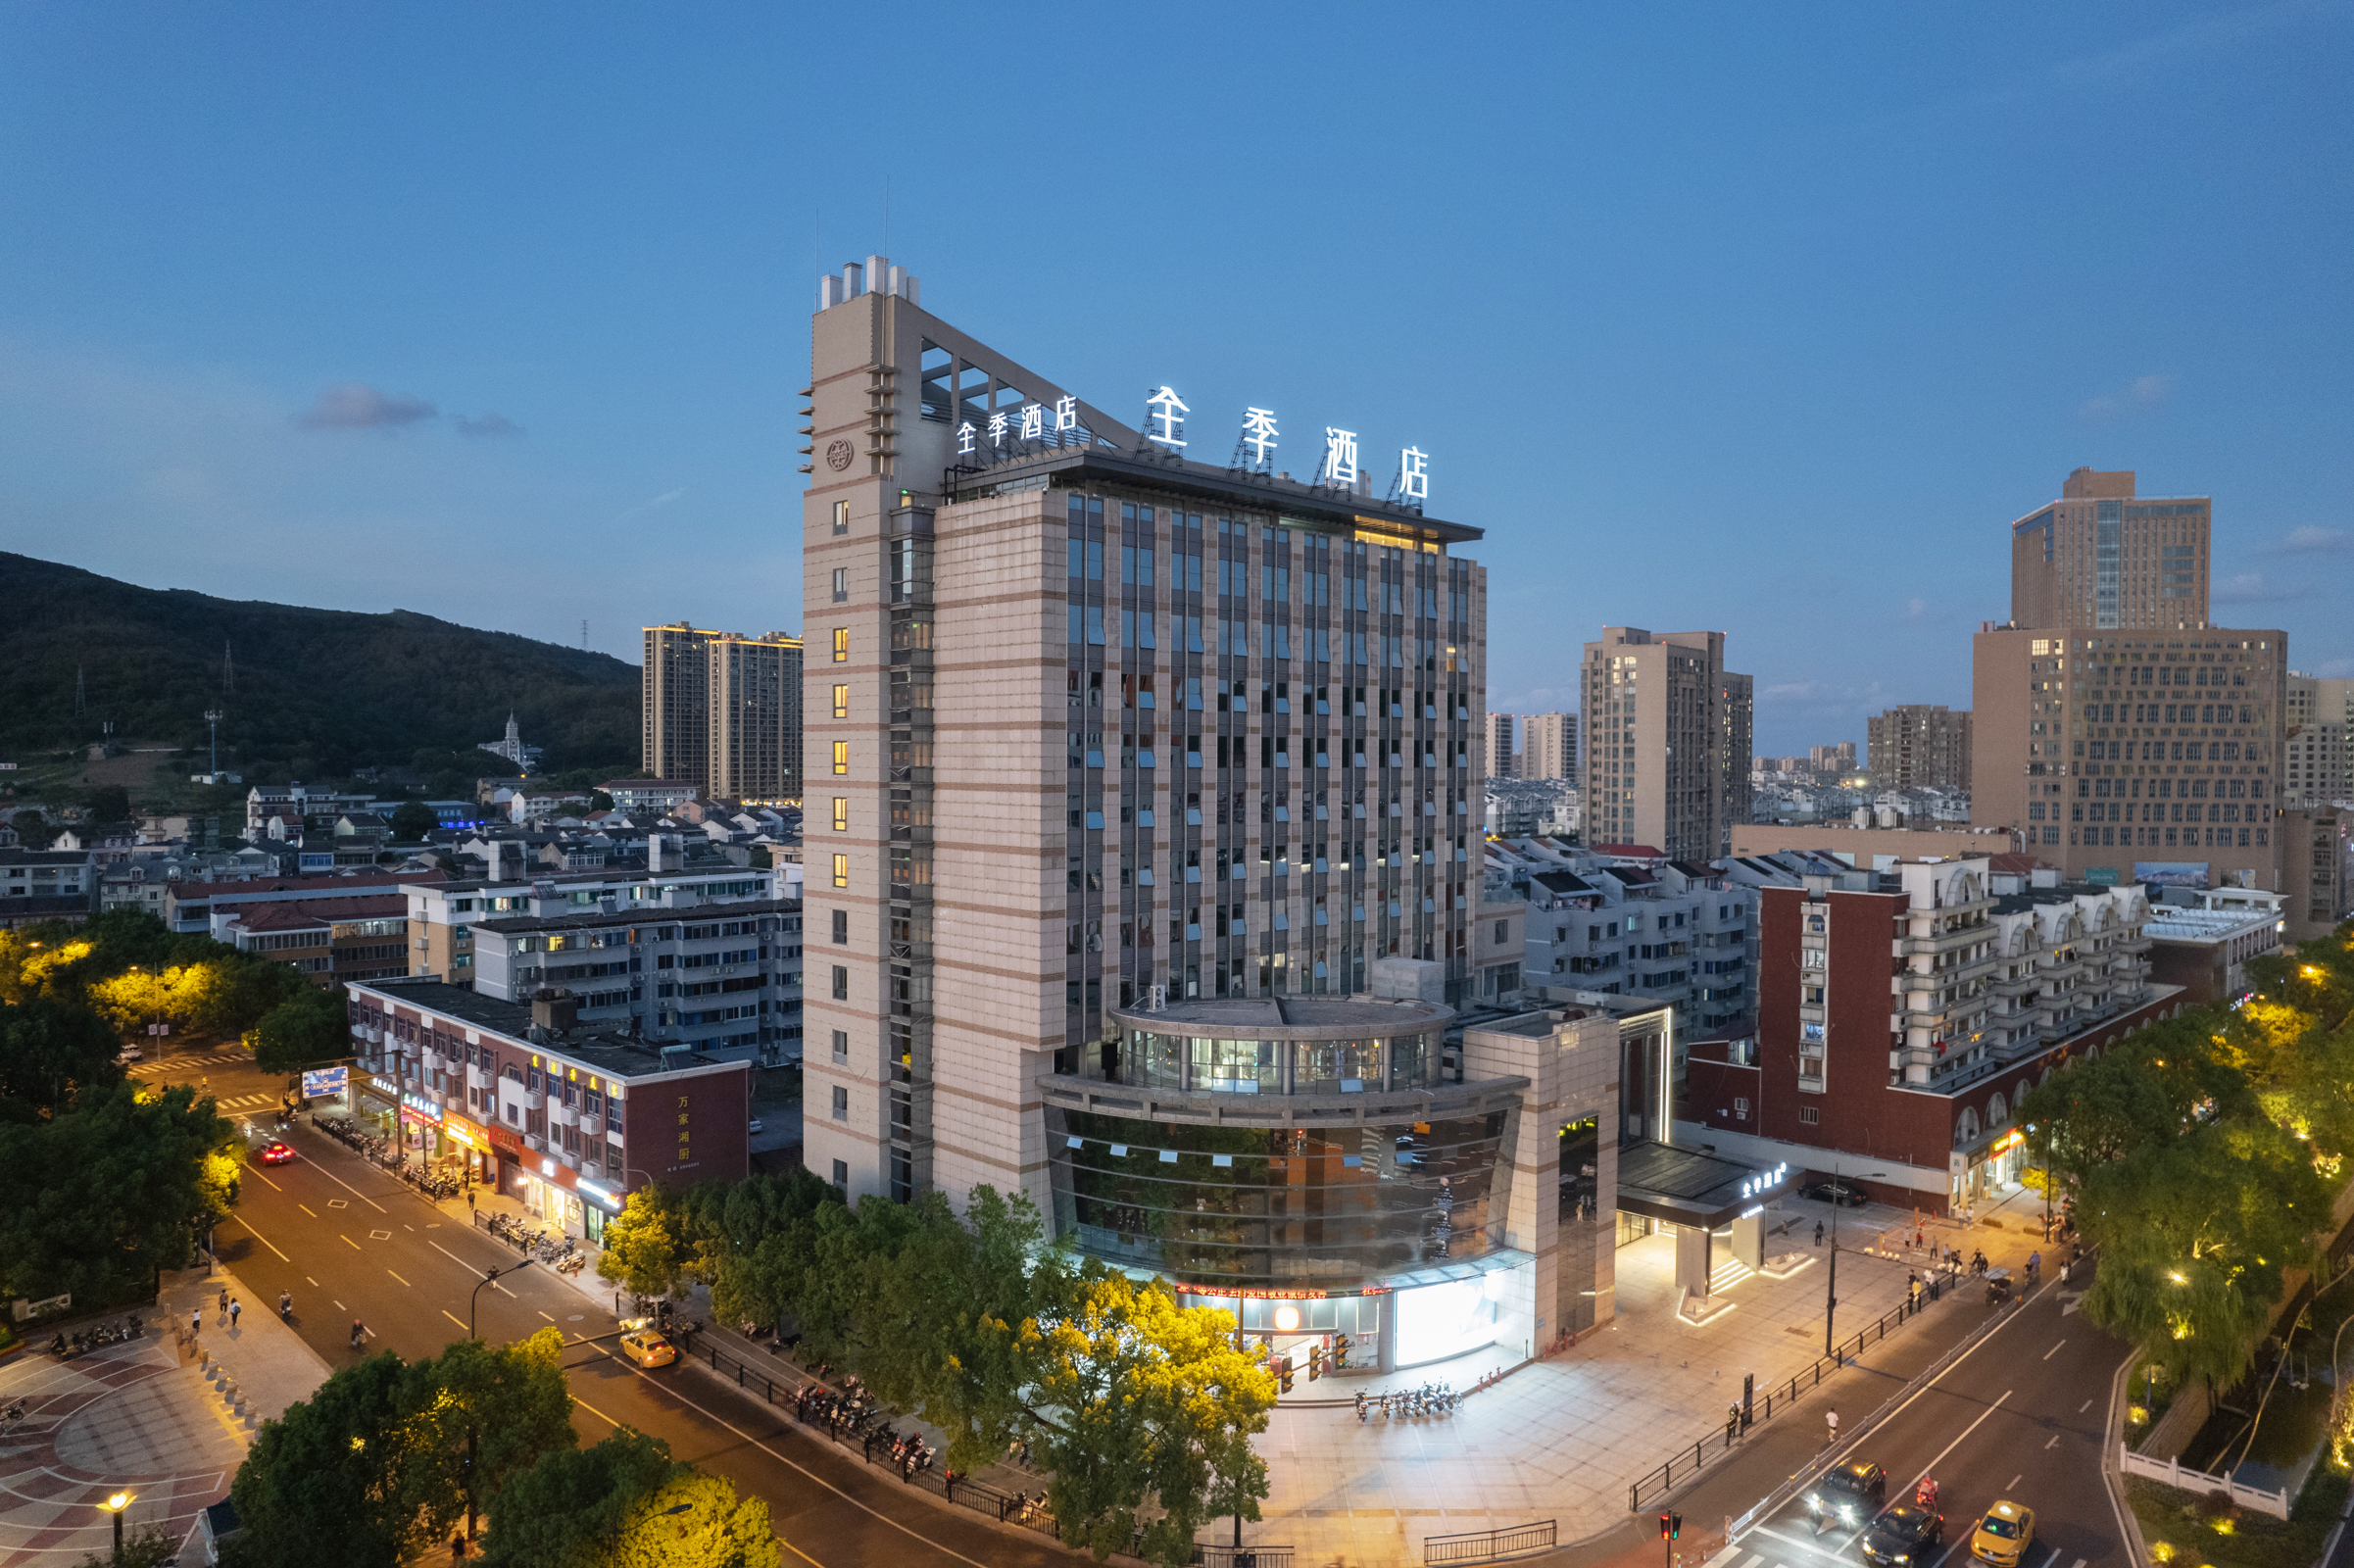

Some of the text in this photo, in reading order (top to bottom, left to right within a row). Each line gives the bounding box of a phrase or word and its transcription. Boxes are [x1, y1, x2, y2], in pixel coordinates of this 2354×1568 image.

[956, 395, 1077, 455] 全季酒店
[1146, 385, 1429, 499] 全季酒店
[677, 1096, 690, 1160] 万家湘厨
